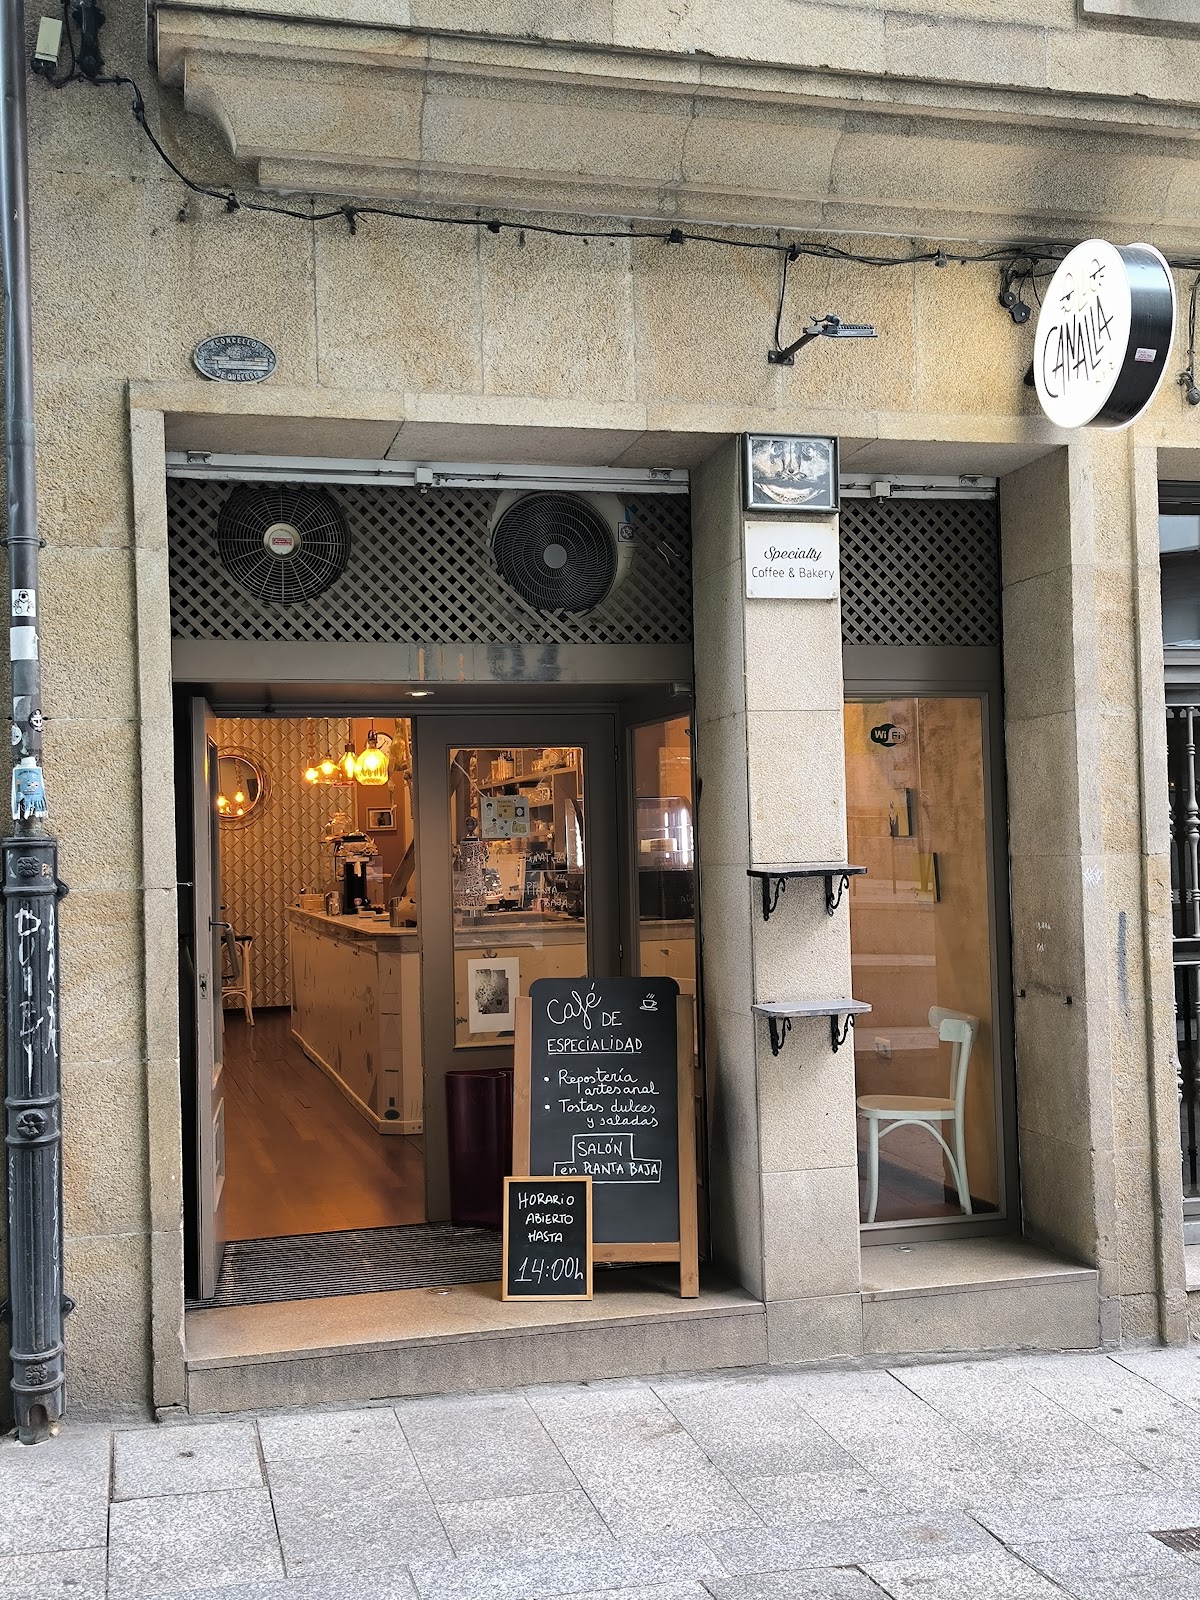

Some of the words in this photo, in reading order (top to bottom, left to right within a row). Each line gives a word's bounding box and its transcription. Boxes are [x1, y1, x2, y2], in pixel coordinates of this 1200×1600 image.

[214, 336, 257, 348] CONCELLO
[1042, 294, 1114, 399] CANALLA
[227, 371, 259, 381] OURENSE
[763, 545, 822, 562] Specialty
[751, 566, 785, 578] Coffee
[788, 566, 795, 578] &
[798, 566, 835, 581] Bakery
[546, 982, 602, 1031] Café
[601, 1010, 623, 1027] DE
[546, 1034, 643, 1054] ESPECIALIDAD
[558, 1066, 639, 1094] Repostería
[584, 1080, 660, 1096] artesanal
[558, 1097, 604, 1114] Tostas
[610, 1098, 656, 1114] dulces
[586, 1116, 595, 1129] y
[599, 1114, 659, 1128] saladas
[576, 1137, 623, 1157] SALÓN
[560, 1165, 577, 1175] en
[582, 1161, 624, 1175] PLANTA
[628, 1161, 659, 1176] BAJA
[518, 1191, 575, 1210] HORARIO
[525, 1212, 574, 1225] ABIERTO
[527, 1229, 563, 1243] HASTA
[514, 1256, 584, 1284] 14:00h
